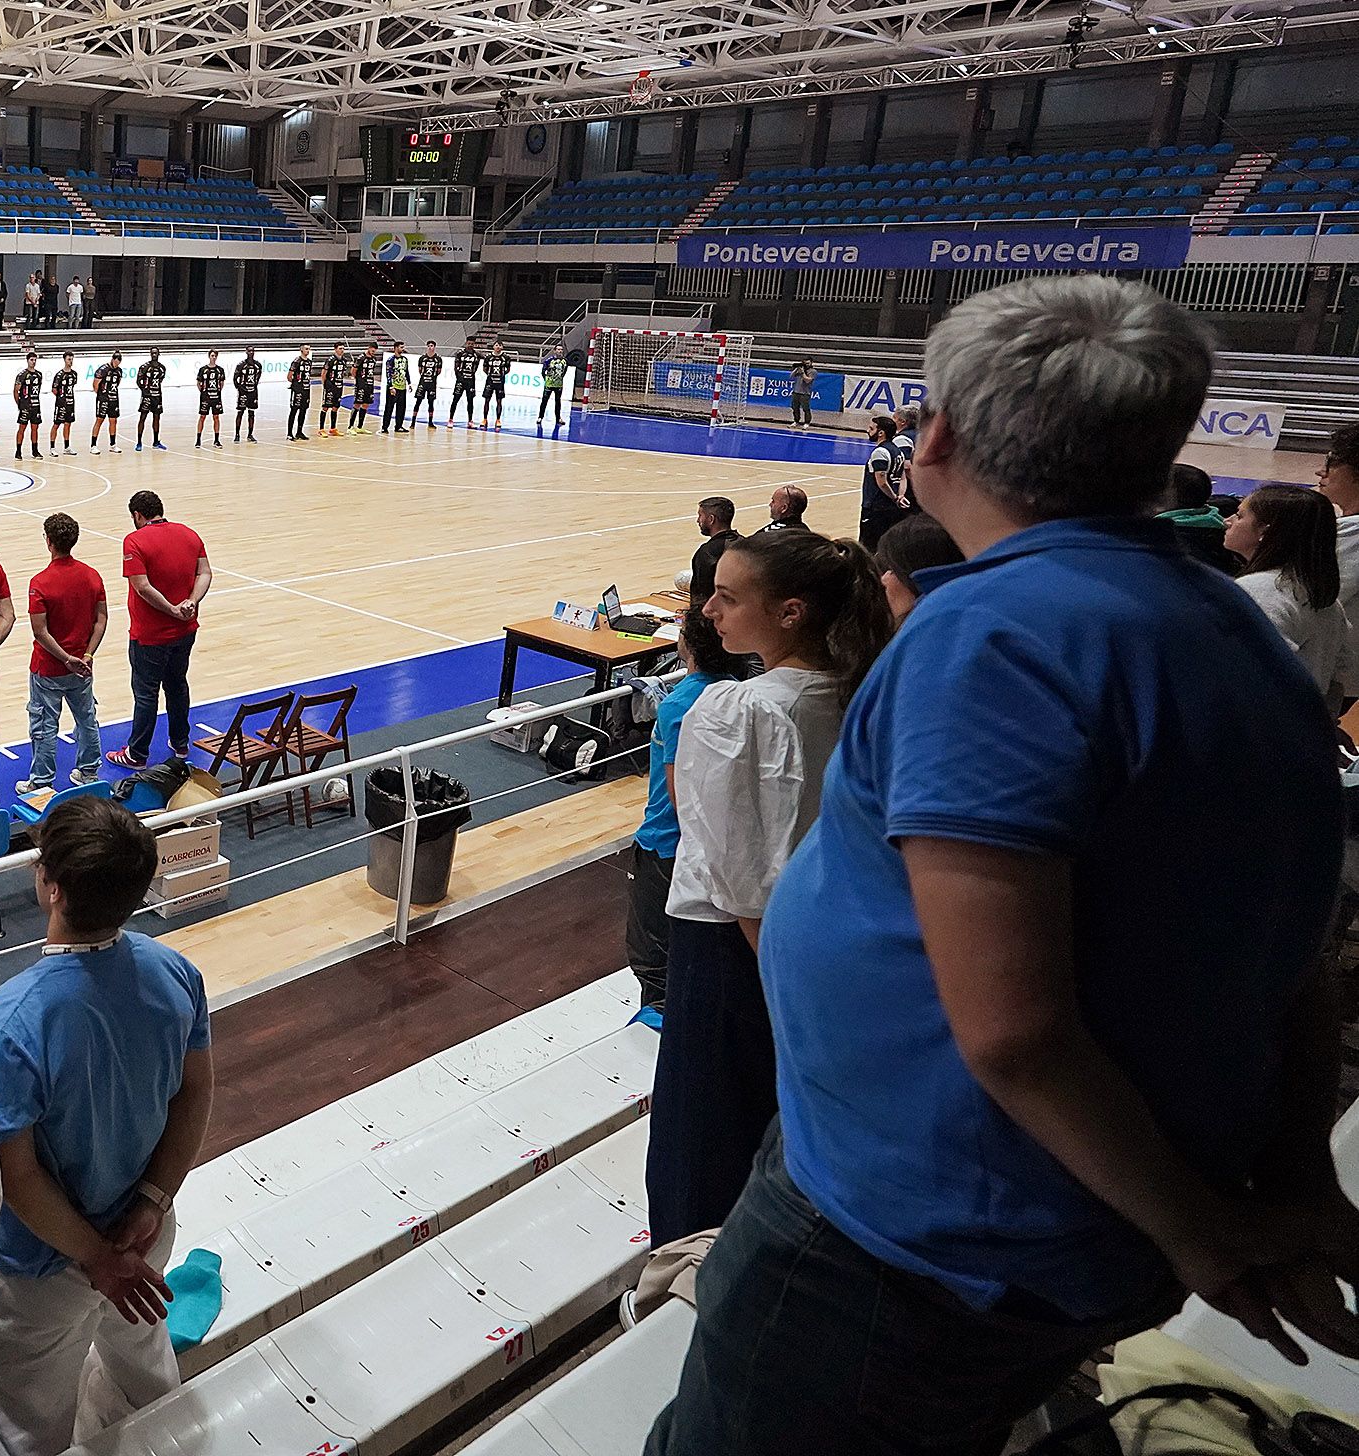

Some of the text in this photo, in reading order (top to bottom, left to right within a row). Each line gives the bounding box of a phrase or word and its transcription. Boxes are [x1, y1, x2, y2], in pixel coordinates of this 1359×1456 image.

[410, 133, 418, 145] 0
[444, 133, 452, 145] 0
[409, 151, 440, 162] 00:00
[703, 239, 859, 264] Pontevedra
[929, 235, 1140, 263] Pontevedra
[683, 371, 715, 382] XUNTA
[683, 379, 694, 388] DE
[768, 379, 794, 388] XUNT
[766, 388, 780, 396] DE
[637, 1096, 650, 1115] 21
[533, 1152, 549, 1175] 23
[411, 1223, 430, 1245] 25
[504, 1332, 523, 1365] 27
